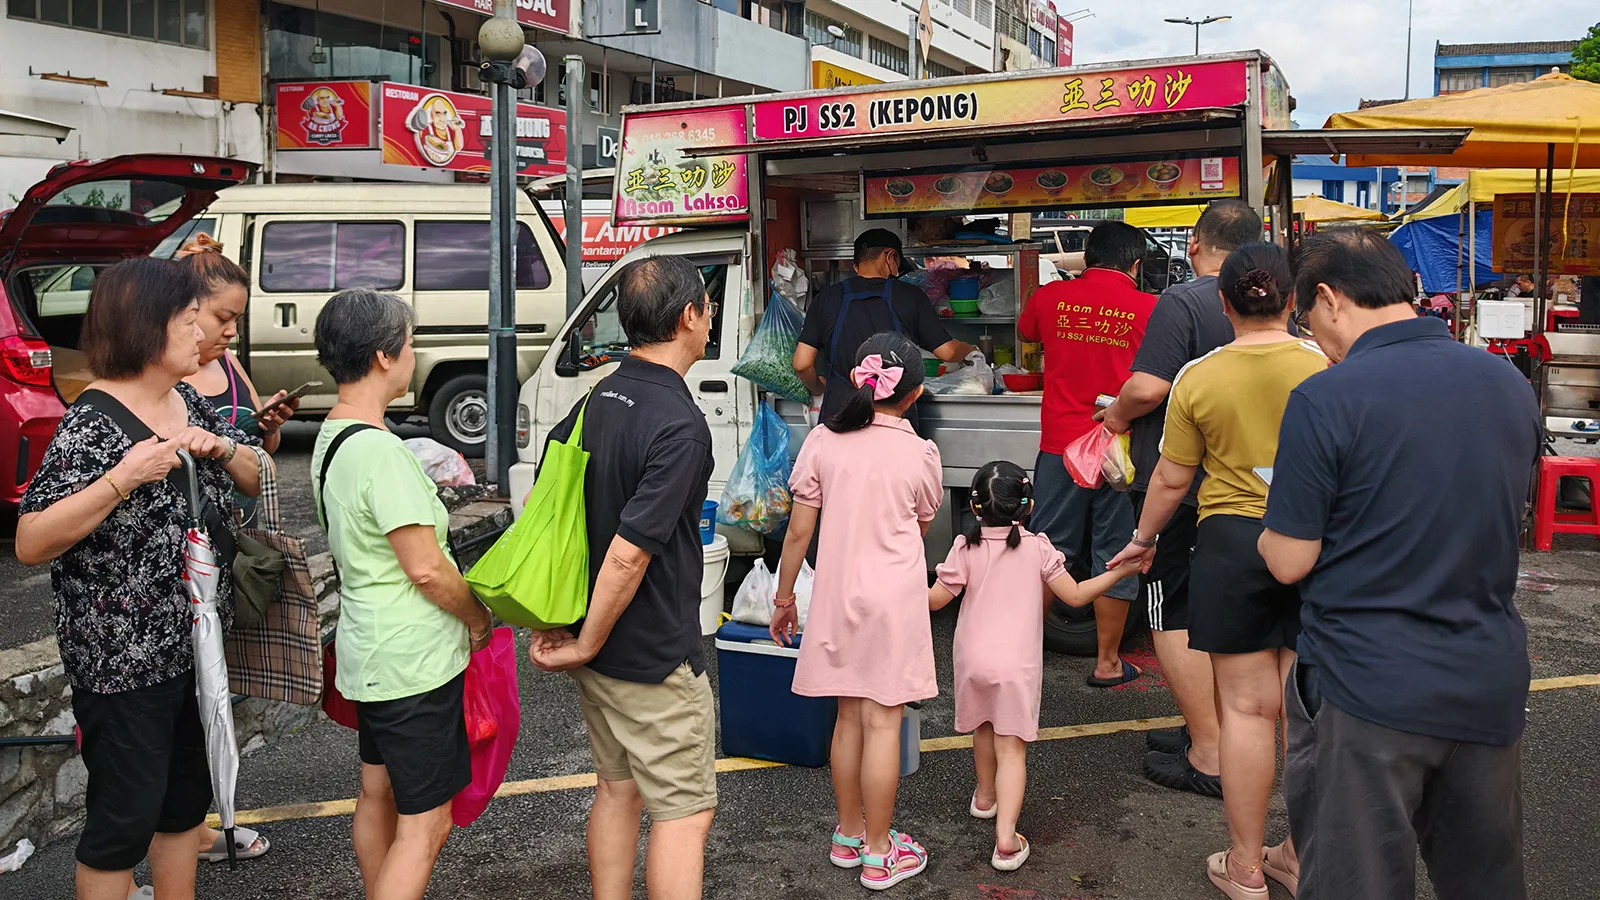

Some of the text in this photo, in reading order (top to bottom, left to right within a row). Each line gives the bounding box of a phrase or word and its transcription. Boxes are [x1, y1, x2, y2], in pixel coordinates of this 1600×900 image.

[516, 0, 556, 17] SAC
[634, 8, 648, 27] L
[385, 88, 418, 101] RESTORAN
[784, 92, 978, 132] PJ SS2 (KEPONG)
[516, 117, 550, 138] HONG
[687, 127, 715, 142] 6345
[625, 192, 739, 216] Asam Laksa
[581, 246, 627, 256] hantaran
[1057, 301, 1092, 313] Asam
[1057, 315, 1132, 336] 亞三叻沙
[1067, 332, 1084, 341] SS2
[1086, 335, 1129, 348] (KEPONG)
